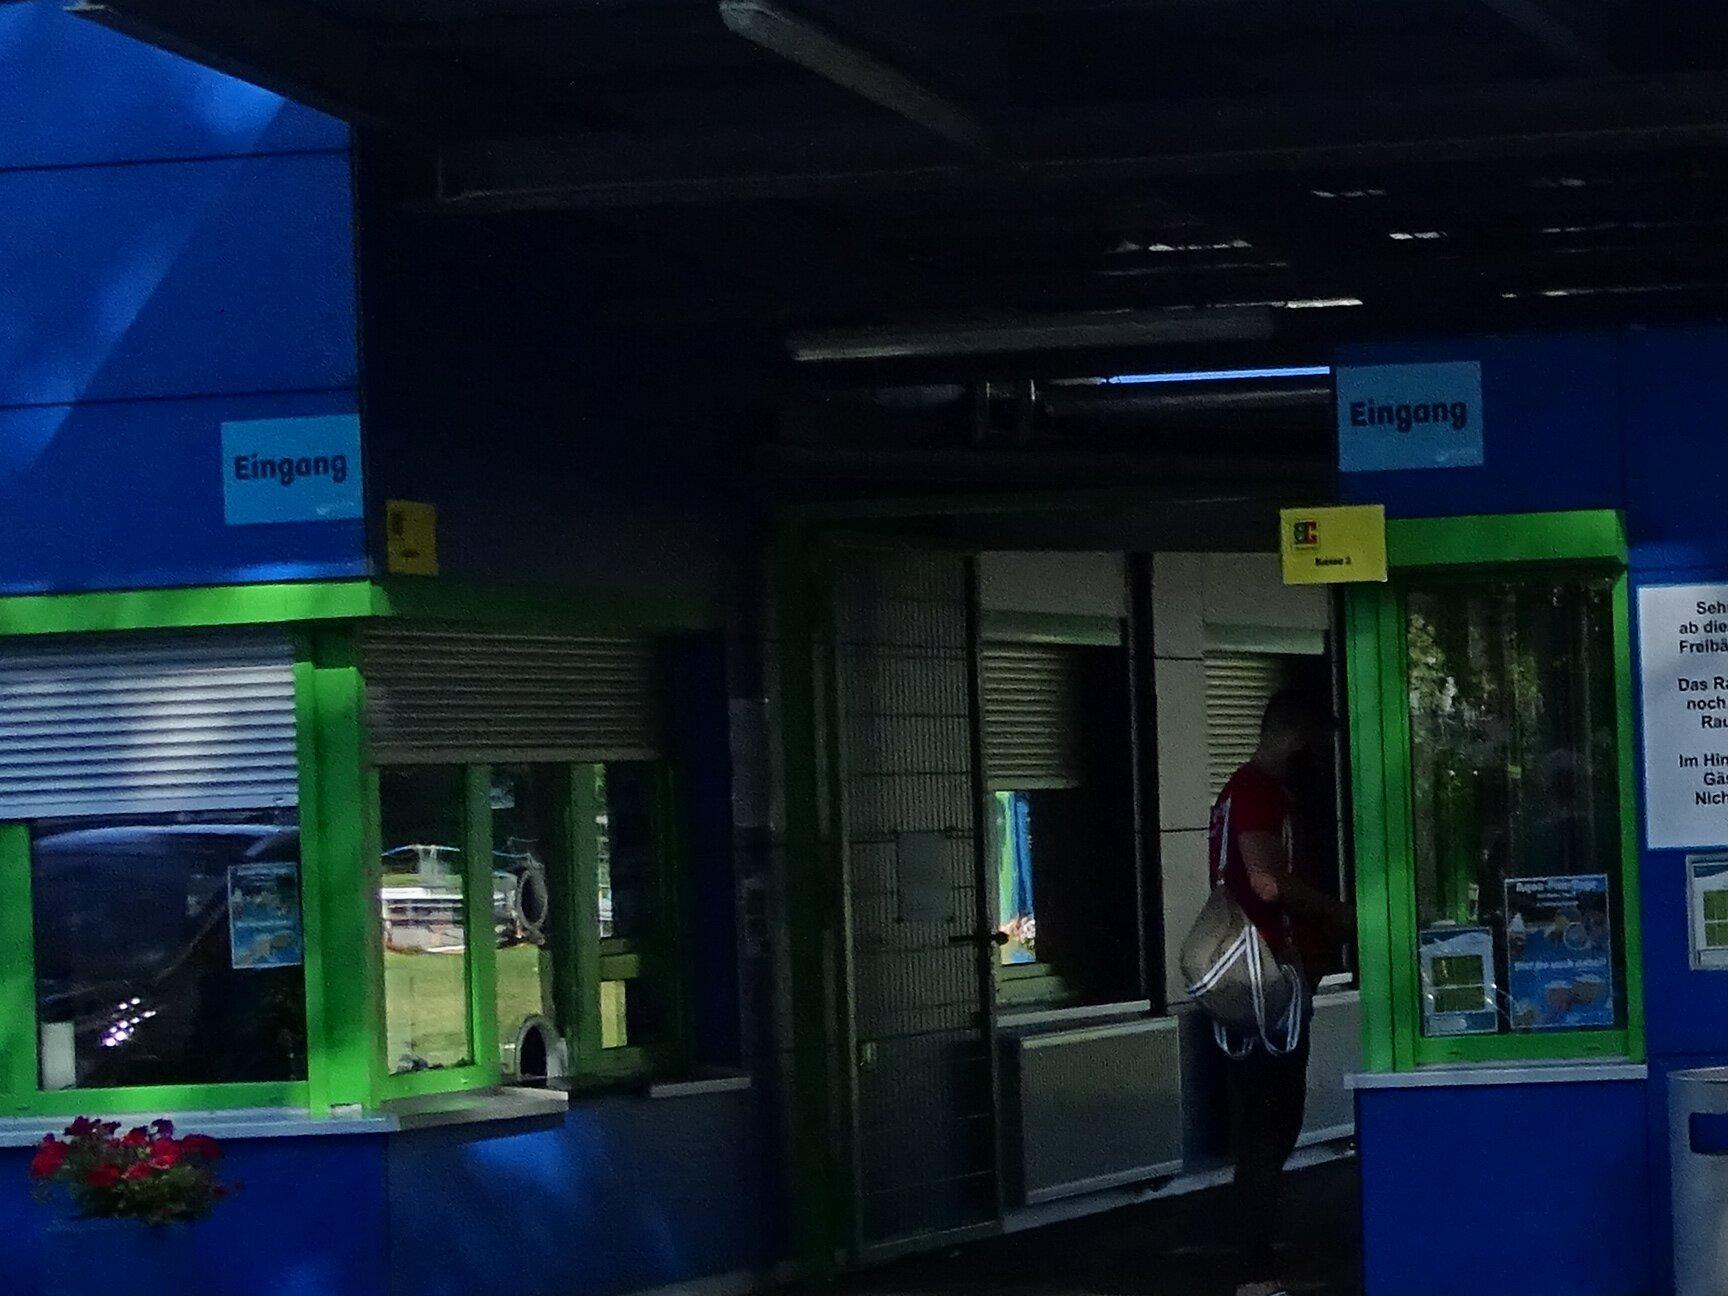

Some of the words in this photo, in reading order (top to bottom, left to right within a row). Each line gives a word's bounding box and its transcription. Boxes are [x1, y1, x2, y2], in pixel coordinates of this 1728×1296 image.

[1350, 397, 1467, 433] Eingang
[234, 453, 347, 486] Eingang
[1679, 621, 1699, 634] ab
[1678, 678, 1708, 692] Das
[1687, 696, 1726, 710] noch
[1679, 754, 1698, 768] Im
